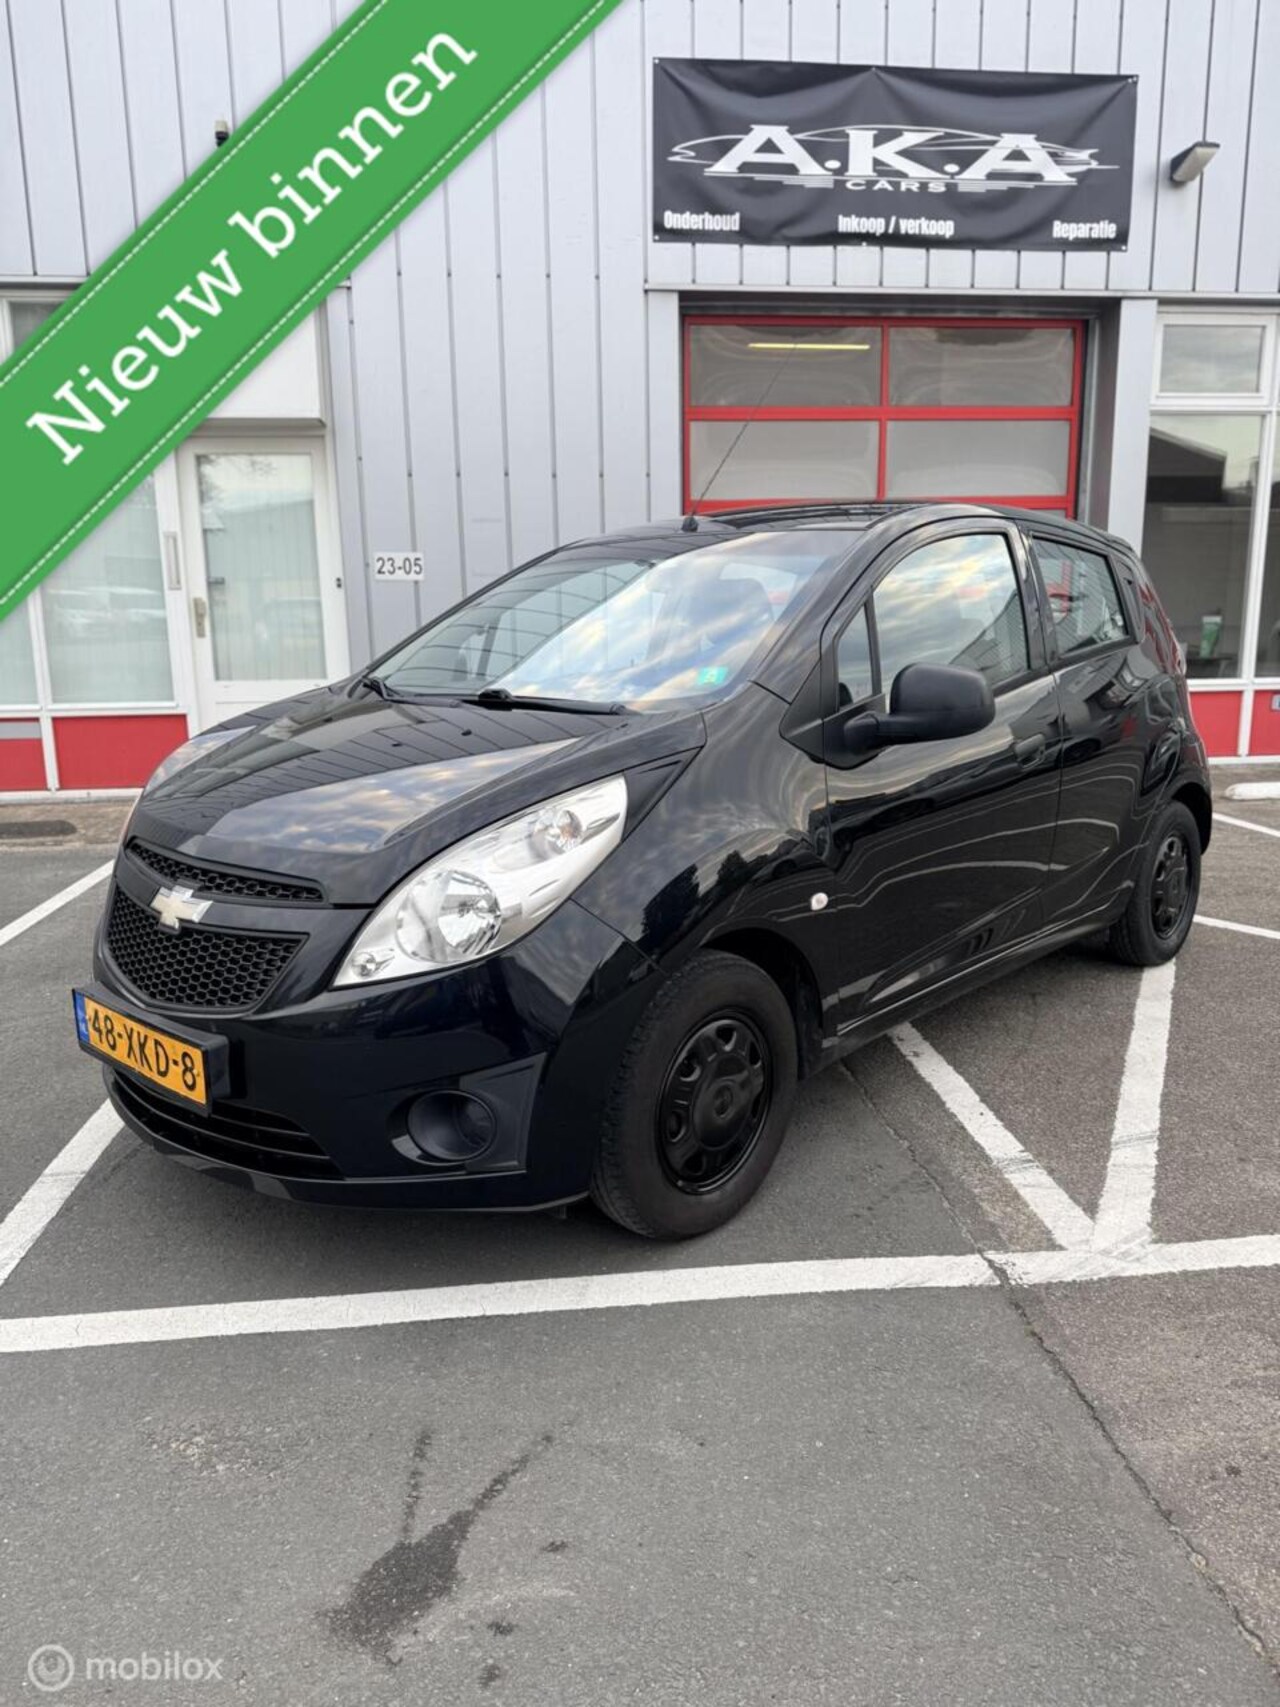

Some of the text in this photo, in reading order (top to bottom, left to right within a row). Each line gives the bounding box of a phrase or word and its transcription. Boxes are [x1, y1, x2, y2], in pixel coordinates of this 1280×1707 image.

[845, 179, 947, 193] CARS
[663, 209, 740, 232] Onderhoud
[837, 214, 955, 238] Inkoop / verkoop
[1052, 220, 1117, 240] Reparatie
[376, 556, 423, 576] 23-05
[91, 1009, 197, 1092] 48-XKD-8
